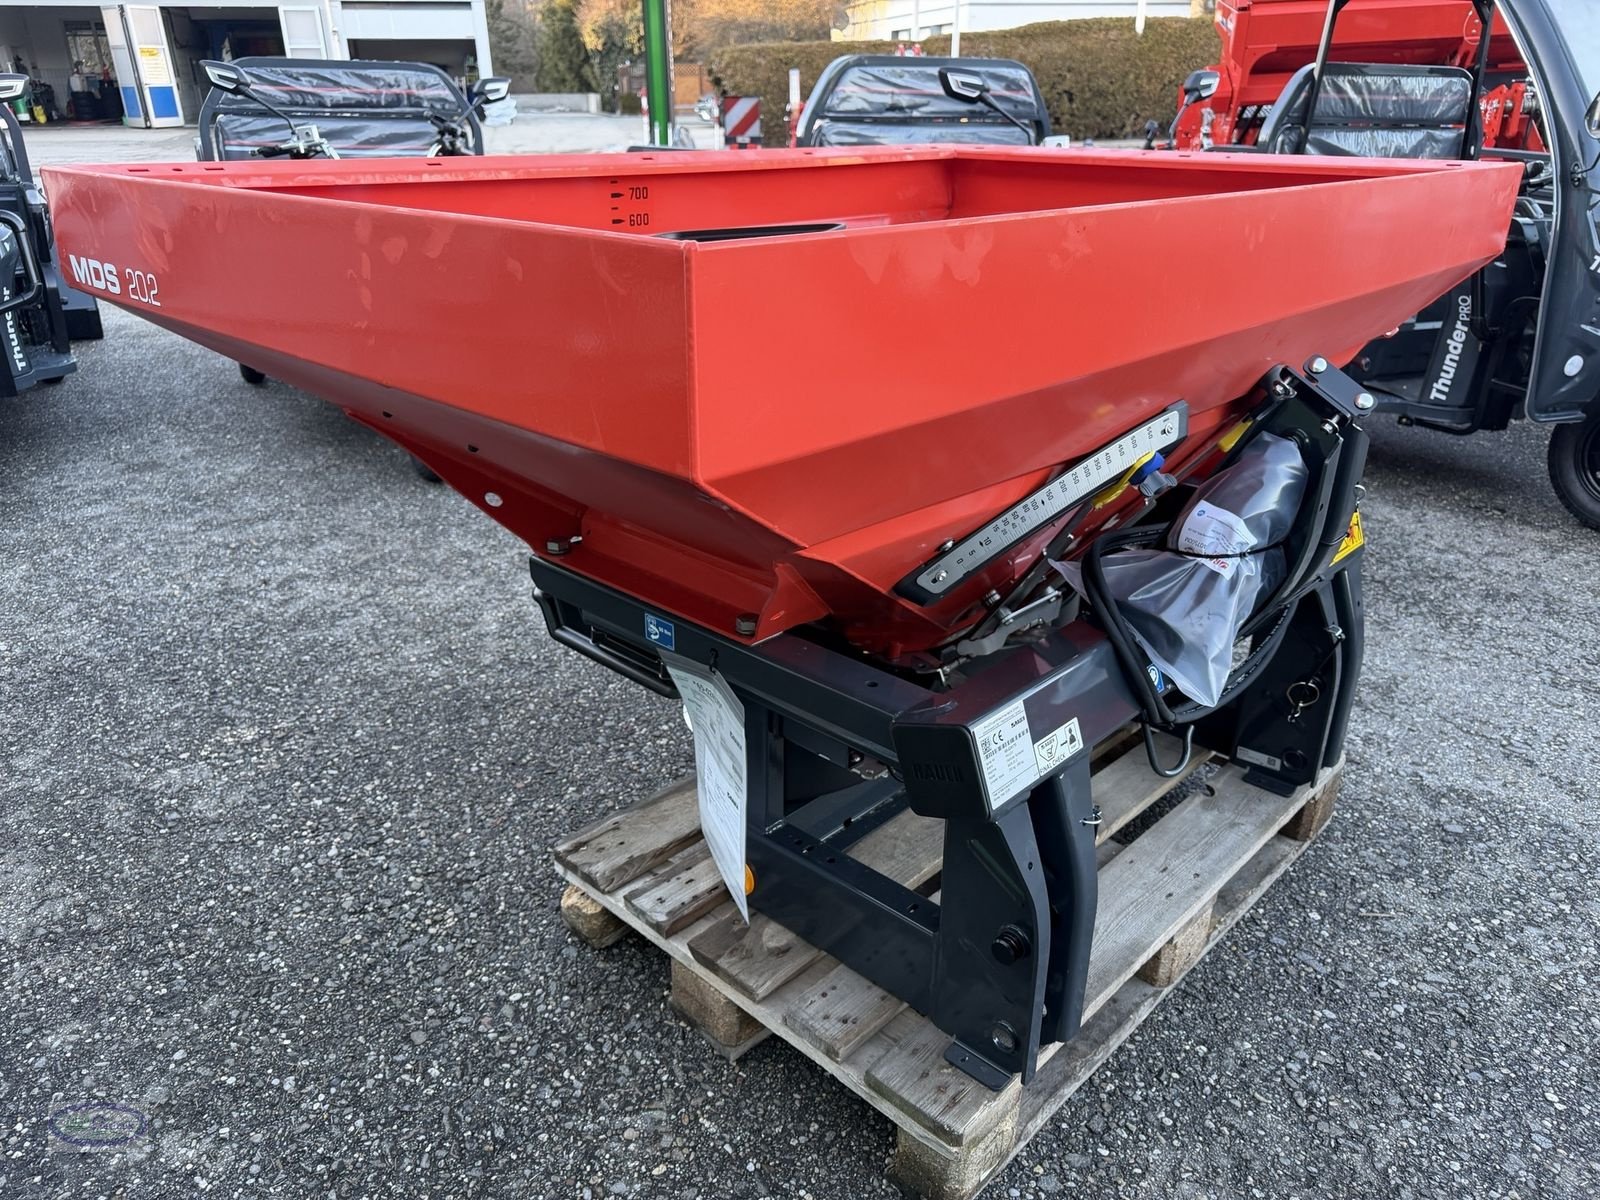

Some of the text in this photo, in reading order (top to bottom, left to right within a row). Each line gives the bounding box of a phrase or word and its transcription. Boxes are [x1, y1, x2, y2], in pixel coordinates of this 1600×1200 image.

[629, 186, 649, 201] 700
[629, 213, 650, 227] 600
[69, 254, 121, 295] MDS
[1130, 435, 1138, 449] 500
[1117, 444, 1125, 457] 450
[1093, 458, 1102, 471] 350
[1104, 452, 1112, 465] 400
[1082, 465, 1091, 478] 300
[1071, 472, 1080, 485] 250
[1058, 480, 1068, 493] 200
[1045, 489, 1054, 501] 150
[1022, 503, 1031, 513] 80
[1030, 499, 1039, 511] 100
[1001, 517, 1010, 527] 30
[1010, 511, 1020, 521] 50
[992, 524, 1000, 533] 15
[1011, 522, 1018, 530] 40
[982, 536, 992, 546] 10
[1040, 753, 1066, 774] FINAL CHECK
